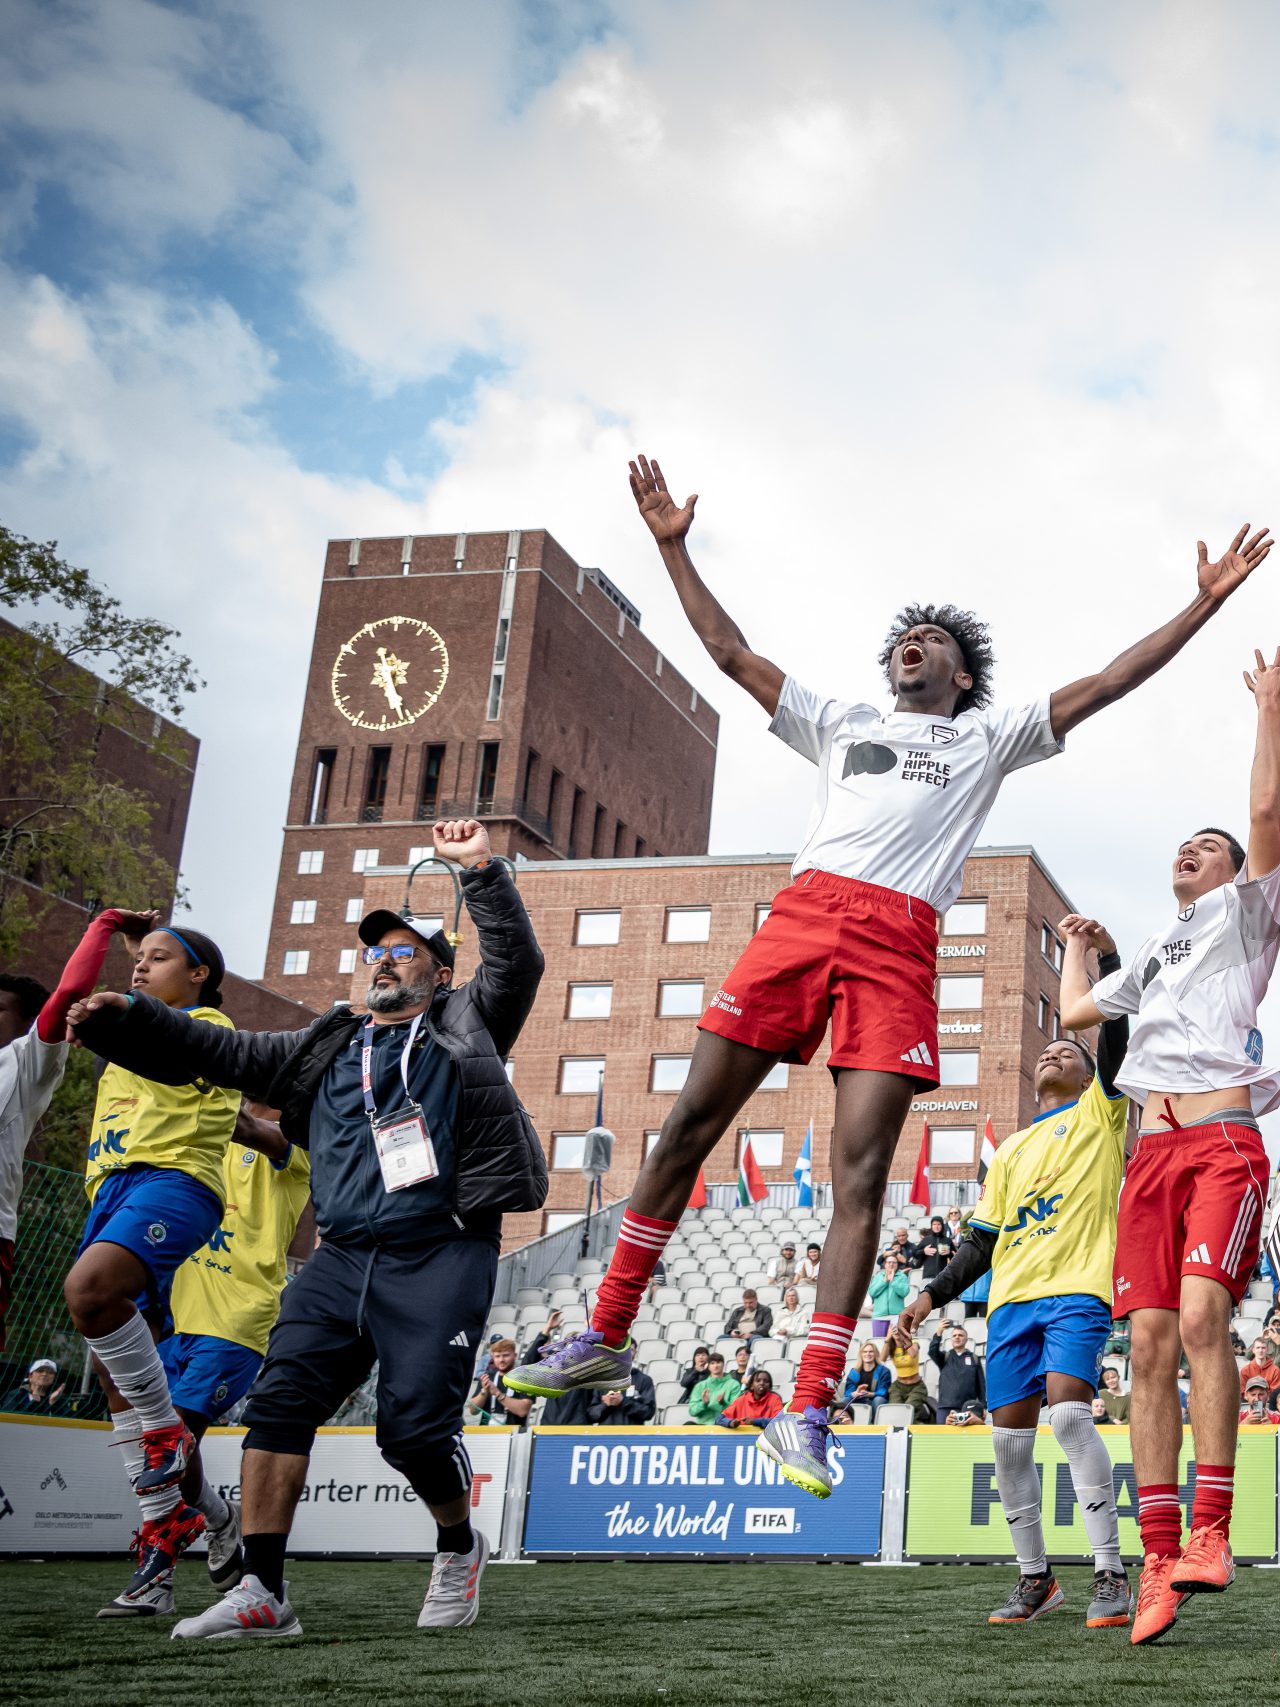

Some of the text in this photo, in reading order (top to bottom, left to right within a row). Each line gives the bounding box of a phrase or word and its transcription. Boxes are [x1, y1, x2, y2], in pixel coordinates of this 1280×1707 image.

[907, 750, 932, 759] THE
[903, 759, 951, 776] RIPPLE
[901, 770, 951, 789] EFFECT
[721, 992, 737, 1003] TEAM
[717, 1001, 743, 1016] ENGLAND
[909, 1101, 978, 1112] ORDHAVEN
[570, 1445, 846, 1486] FOOTBALL UNS
[604, 1500, 734, 1541] the World
[752, 1513, 787, 1527] FIFA
